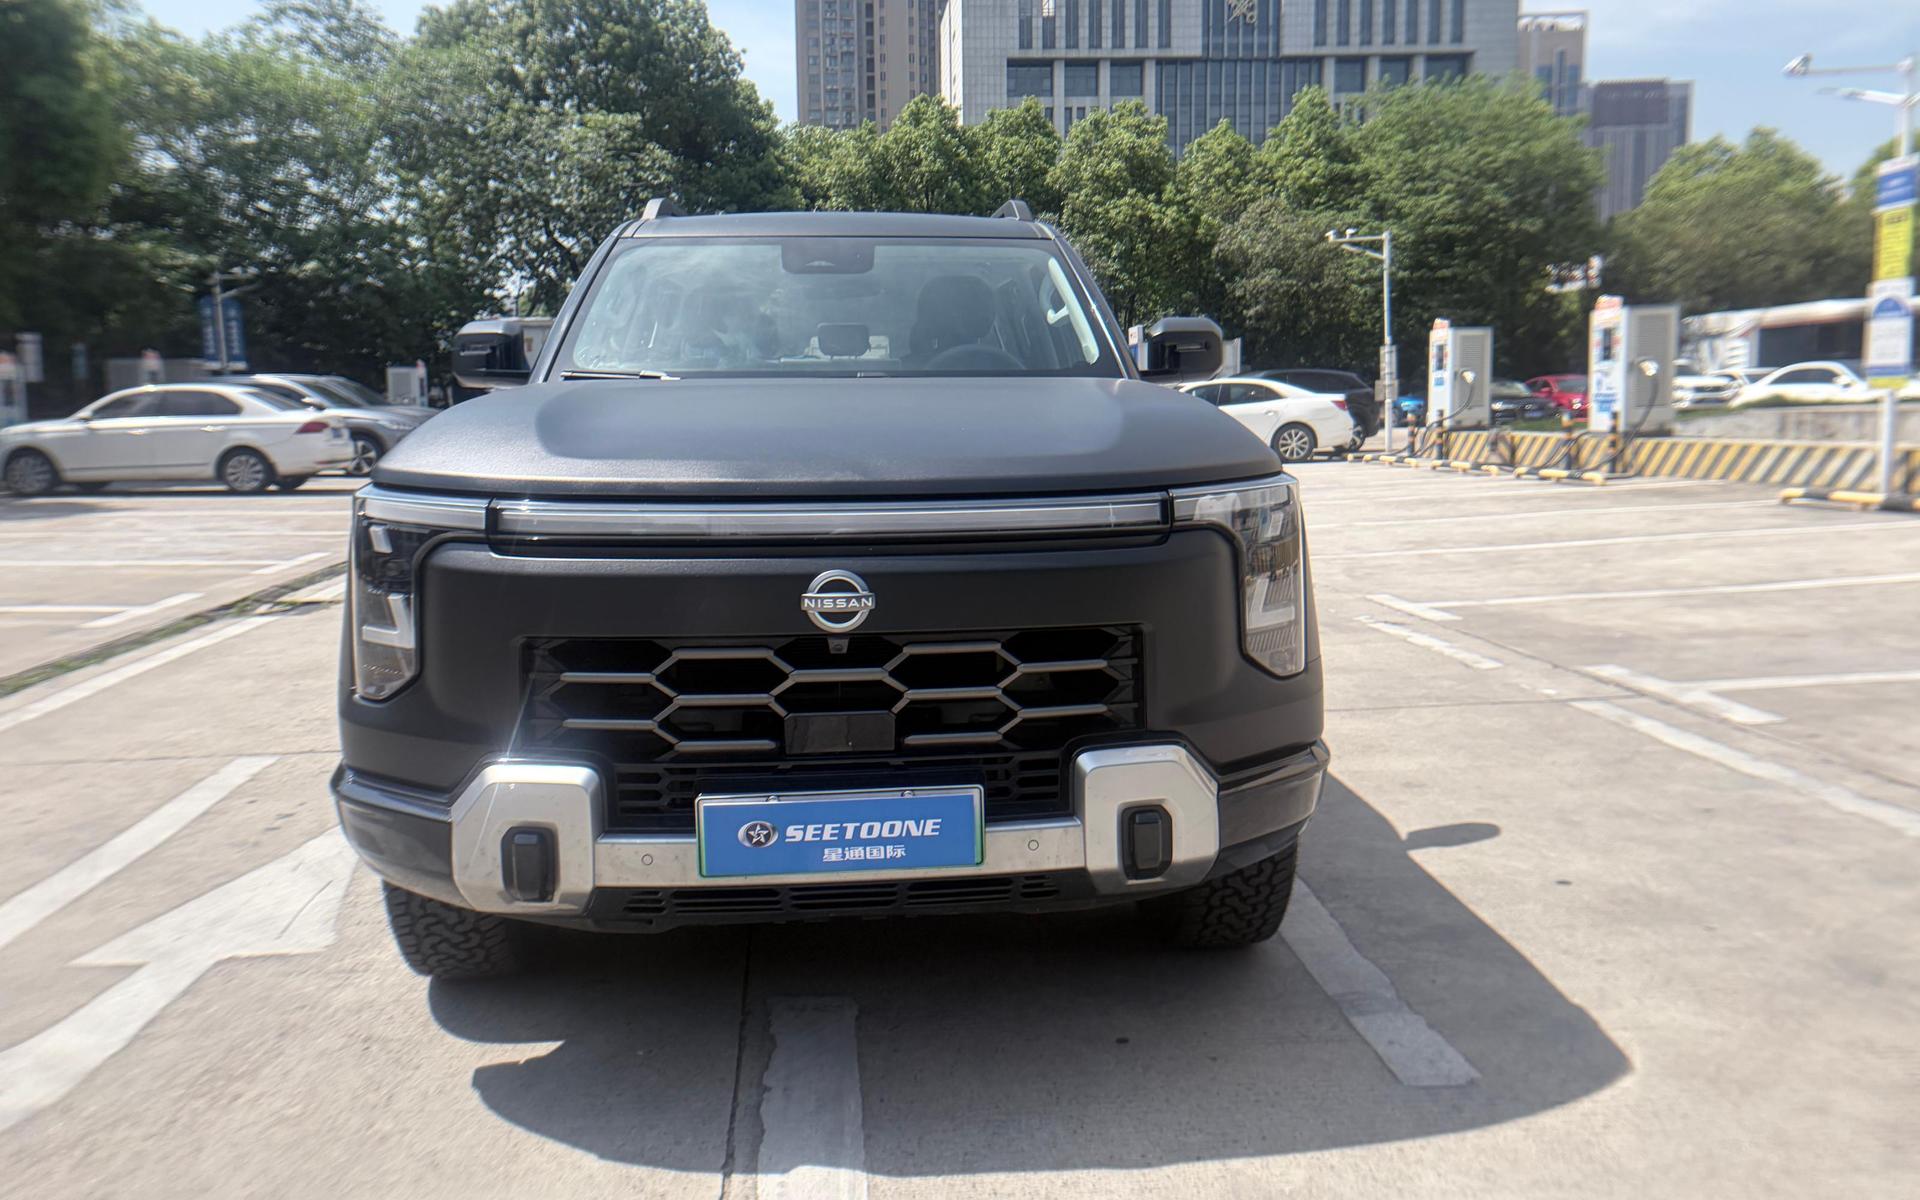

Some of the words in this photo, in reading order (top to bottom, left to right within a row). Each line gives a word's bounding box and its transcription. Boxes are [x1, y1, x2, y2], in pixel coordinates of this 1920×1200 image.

[804, 597, 873, 608] NISSAN
[785, 818, 942, 843] SEETOONE
[822, 844, 907, 862] 星通国际
